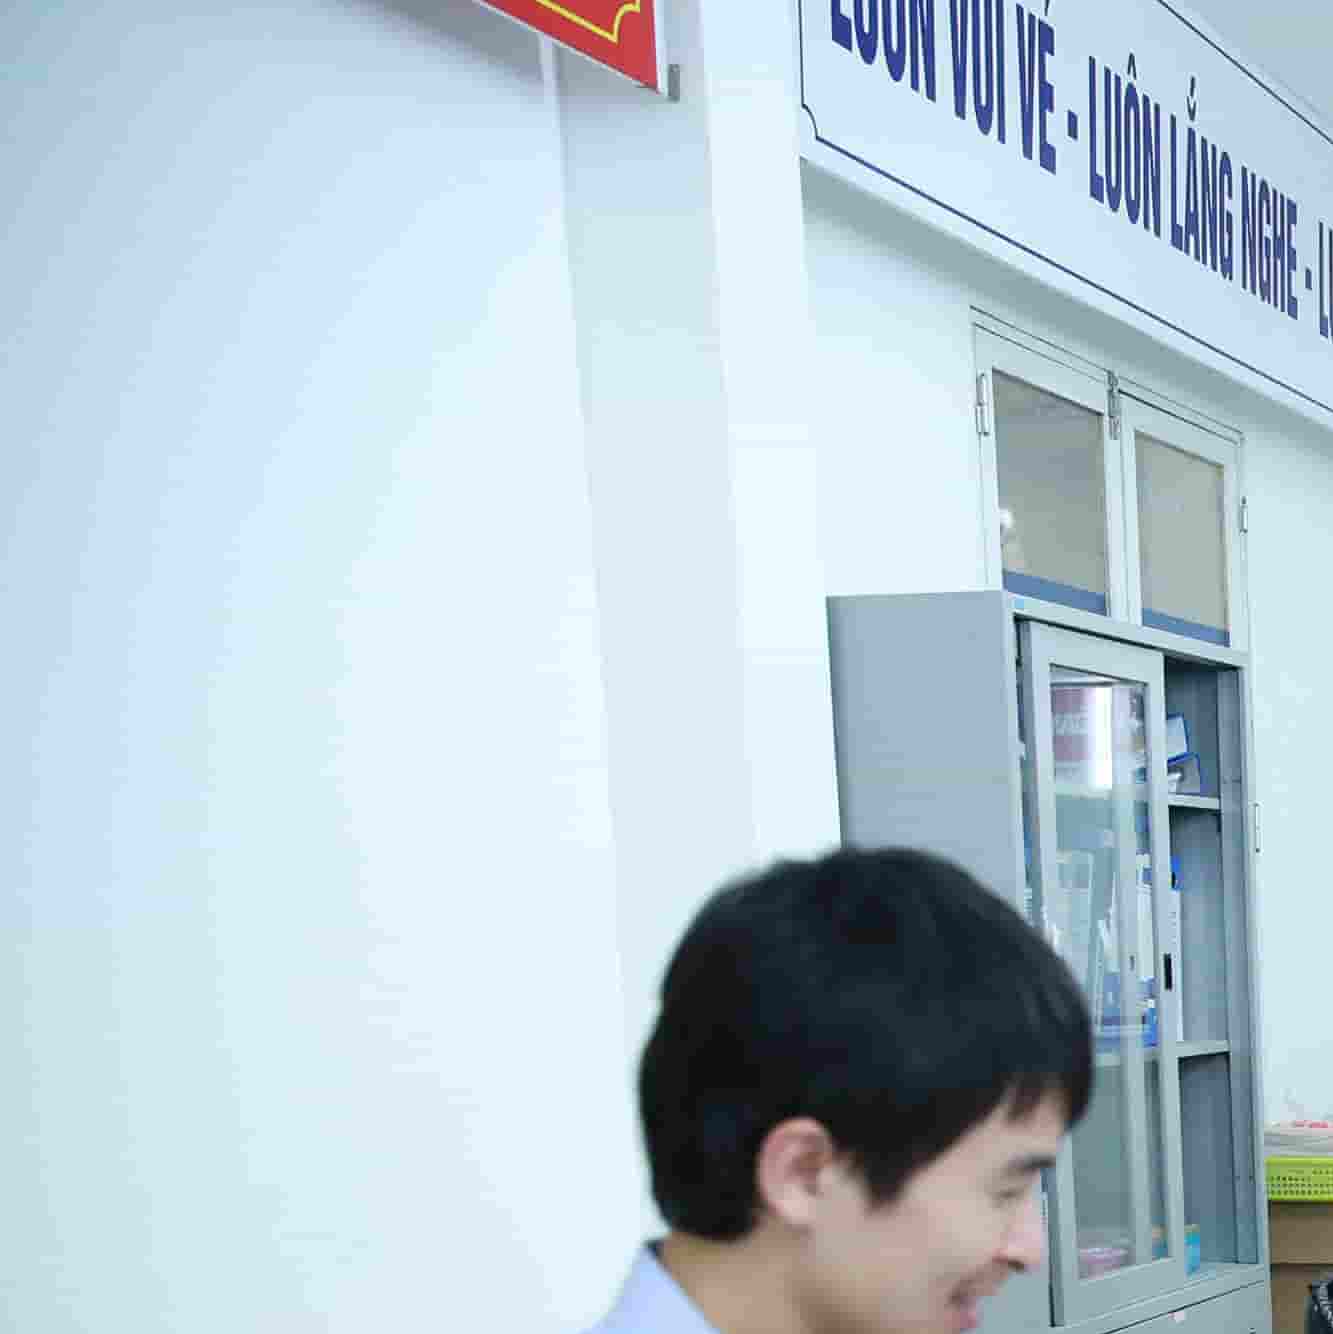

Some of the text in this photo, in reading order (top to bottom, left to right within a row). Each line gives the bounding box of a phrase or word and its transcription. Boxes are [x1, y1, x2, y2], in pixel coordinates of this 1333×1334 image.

[1088, 52, 1161, 239] LUÔN
[1169, 75, 1233, 282] LẮNG
[1240, 165, 1298, 320] NGHE
